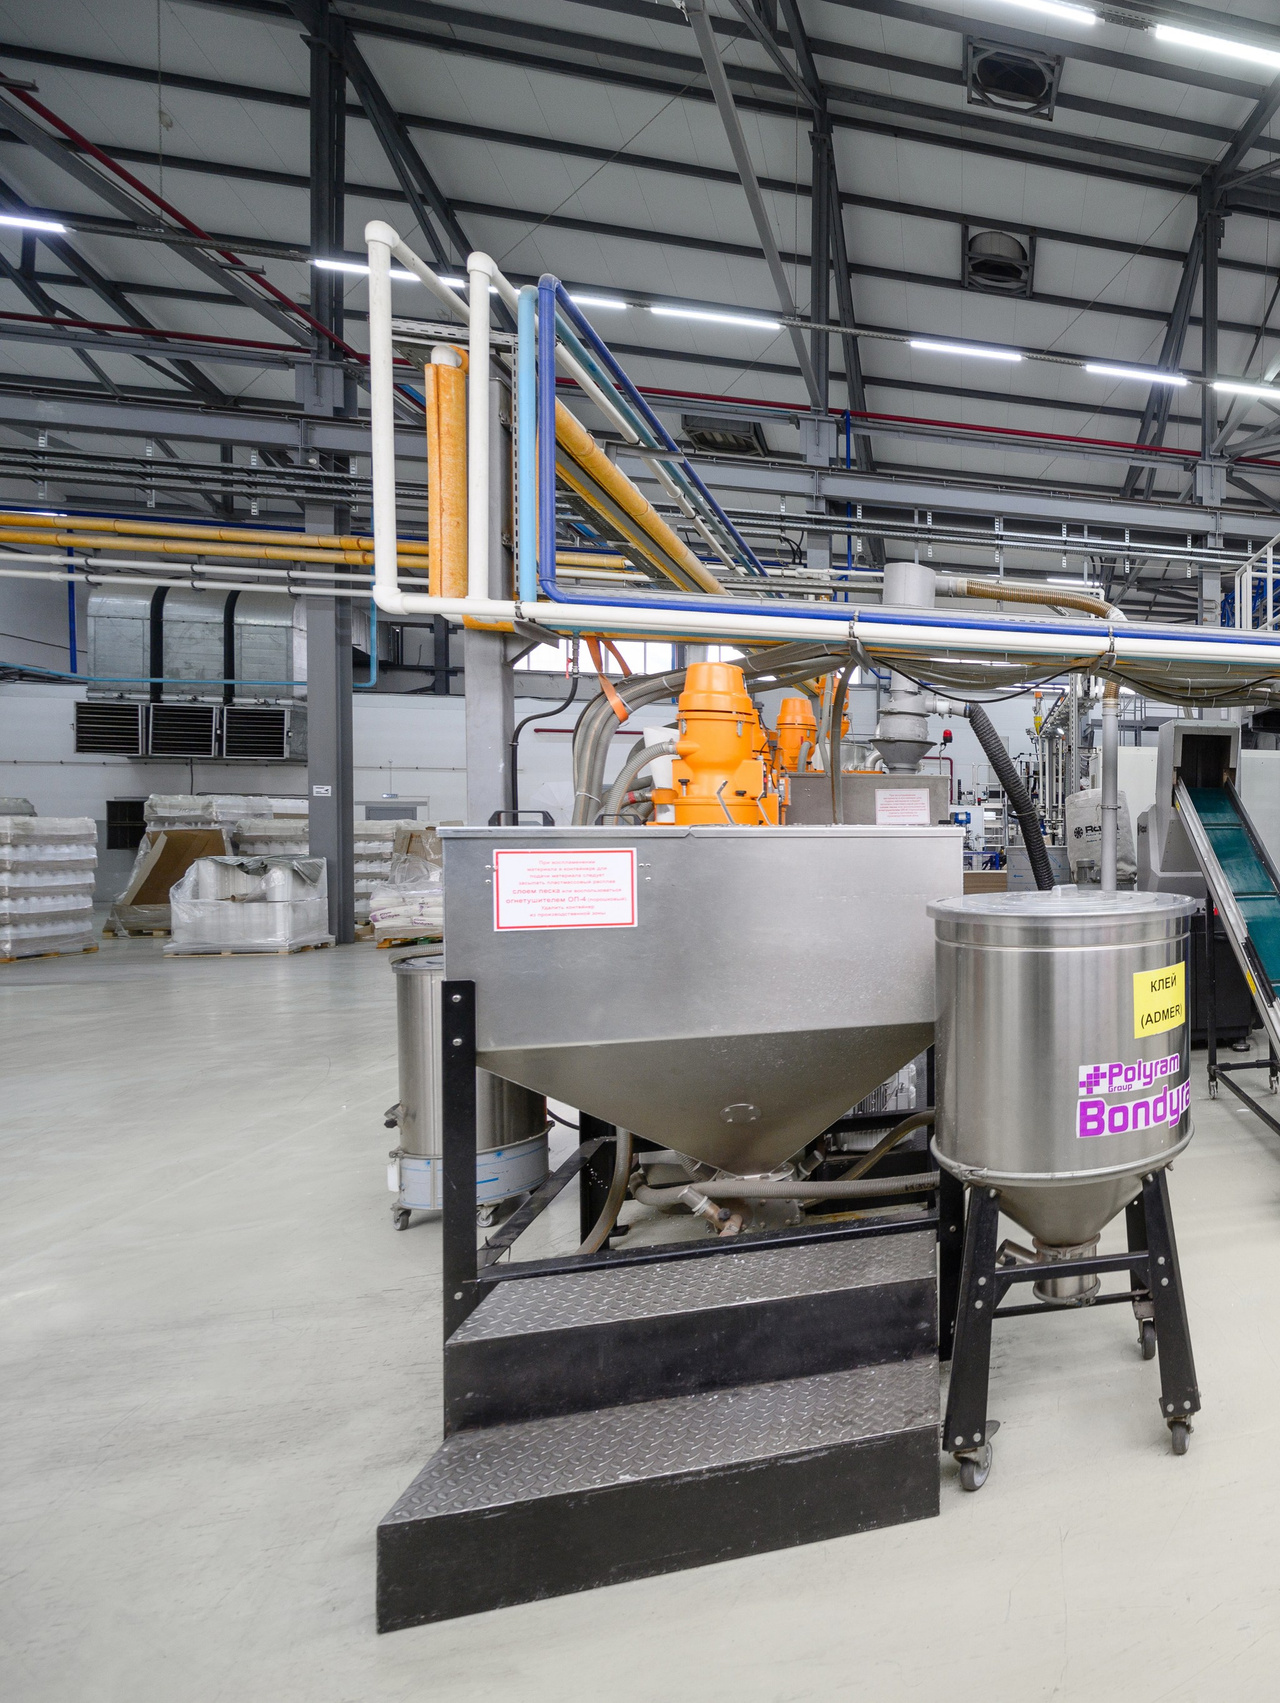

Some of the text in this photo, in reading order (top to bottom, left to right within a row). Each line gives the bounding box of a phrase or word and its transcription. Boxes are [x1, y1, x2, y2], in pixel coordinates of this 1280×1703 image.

[1150, 972, 1177, 993] КЛЕЙ
[1140, 1003, 1183, 1029] (ADMER)
[1108, 1054, 1180, 1086] Polyram
[1108, 1083, 1133, 1092] Group
